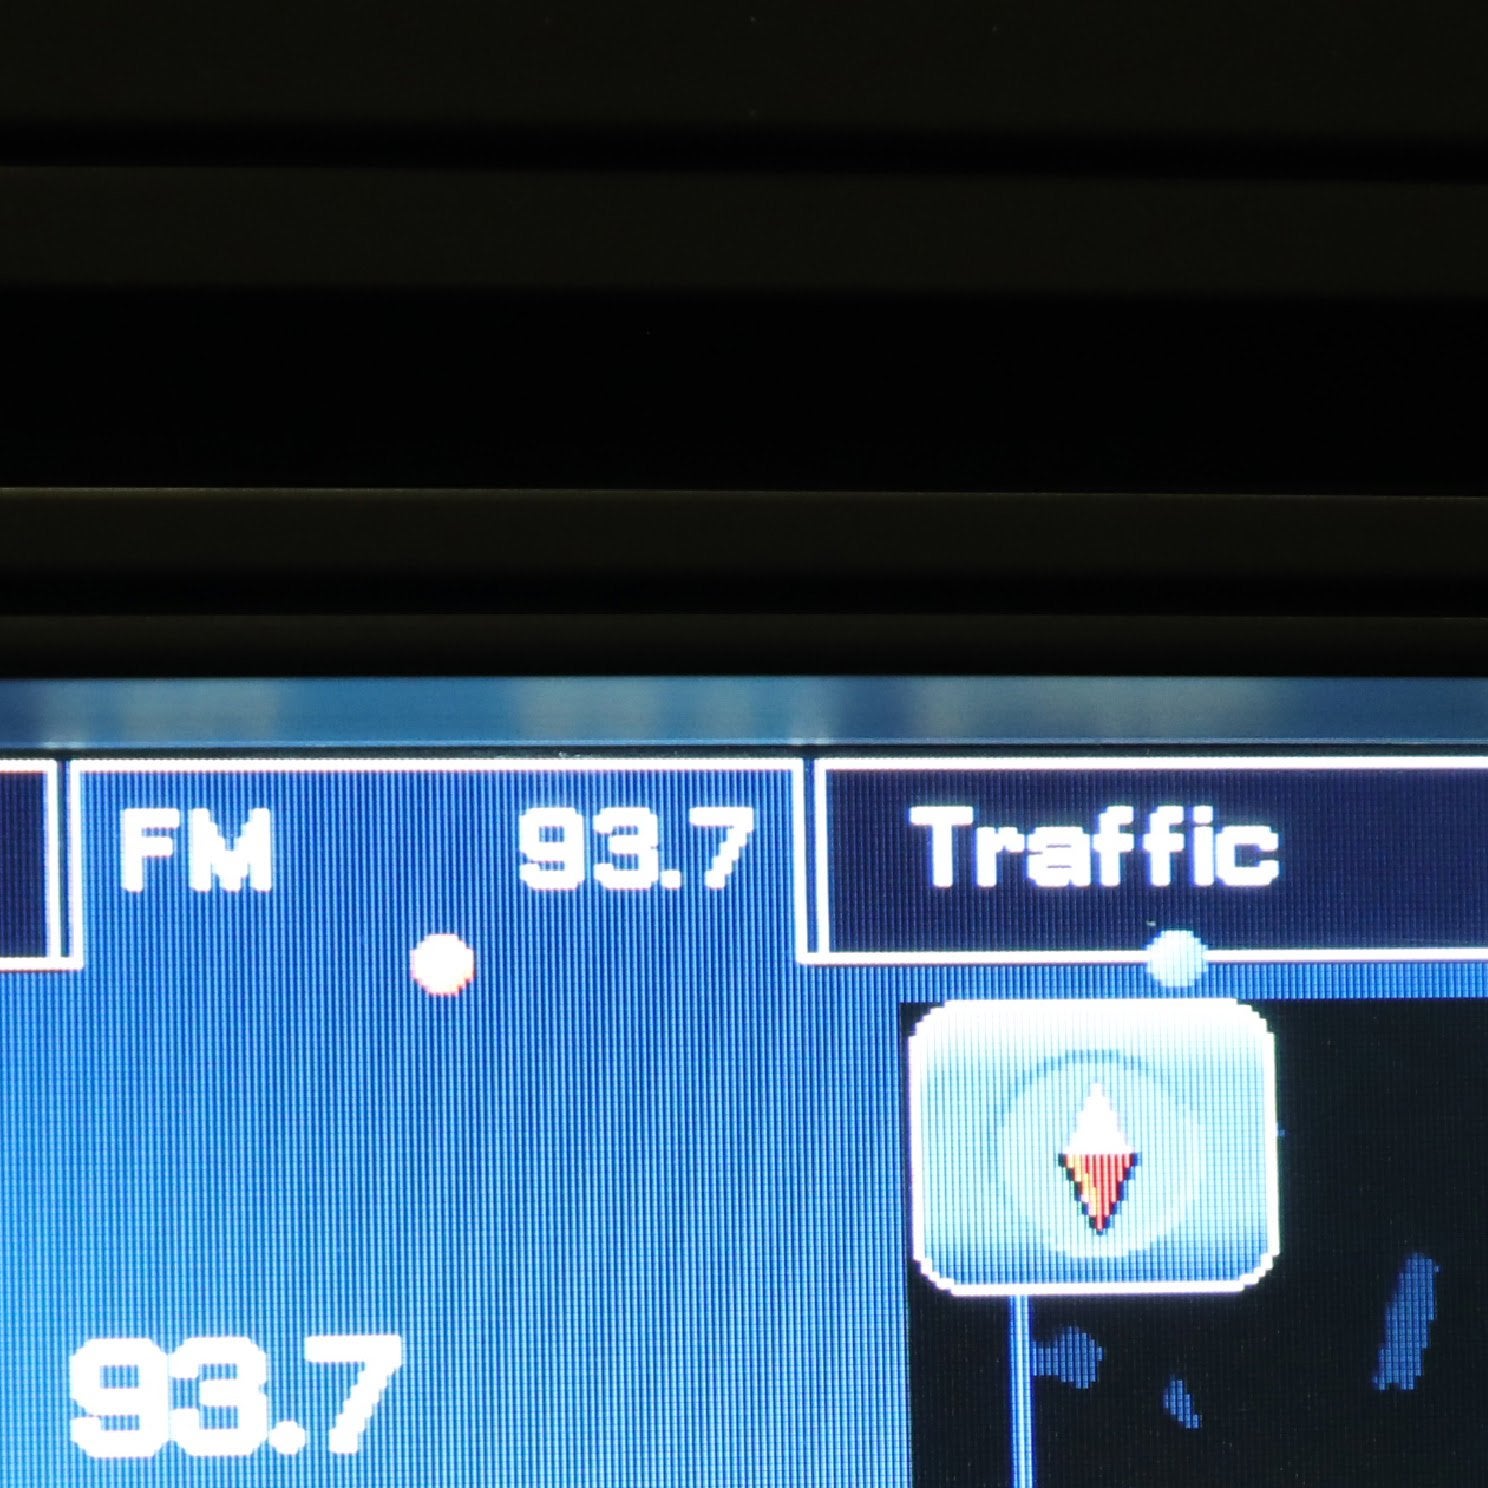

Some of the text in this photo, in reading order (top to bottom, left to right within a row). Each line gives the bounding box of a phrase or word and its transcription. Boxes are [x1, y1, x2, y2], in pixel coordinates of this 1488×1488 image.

[123, 807, 753, 891] FM 93.7
[912, 807, 1277, 886] Traffic
[71, 1334, 402, 1459] 93.7
